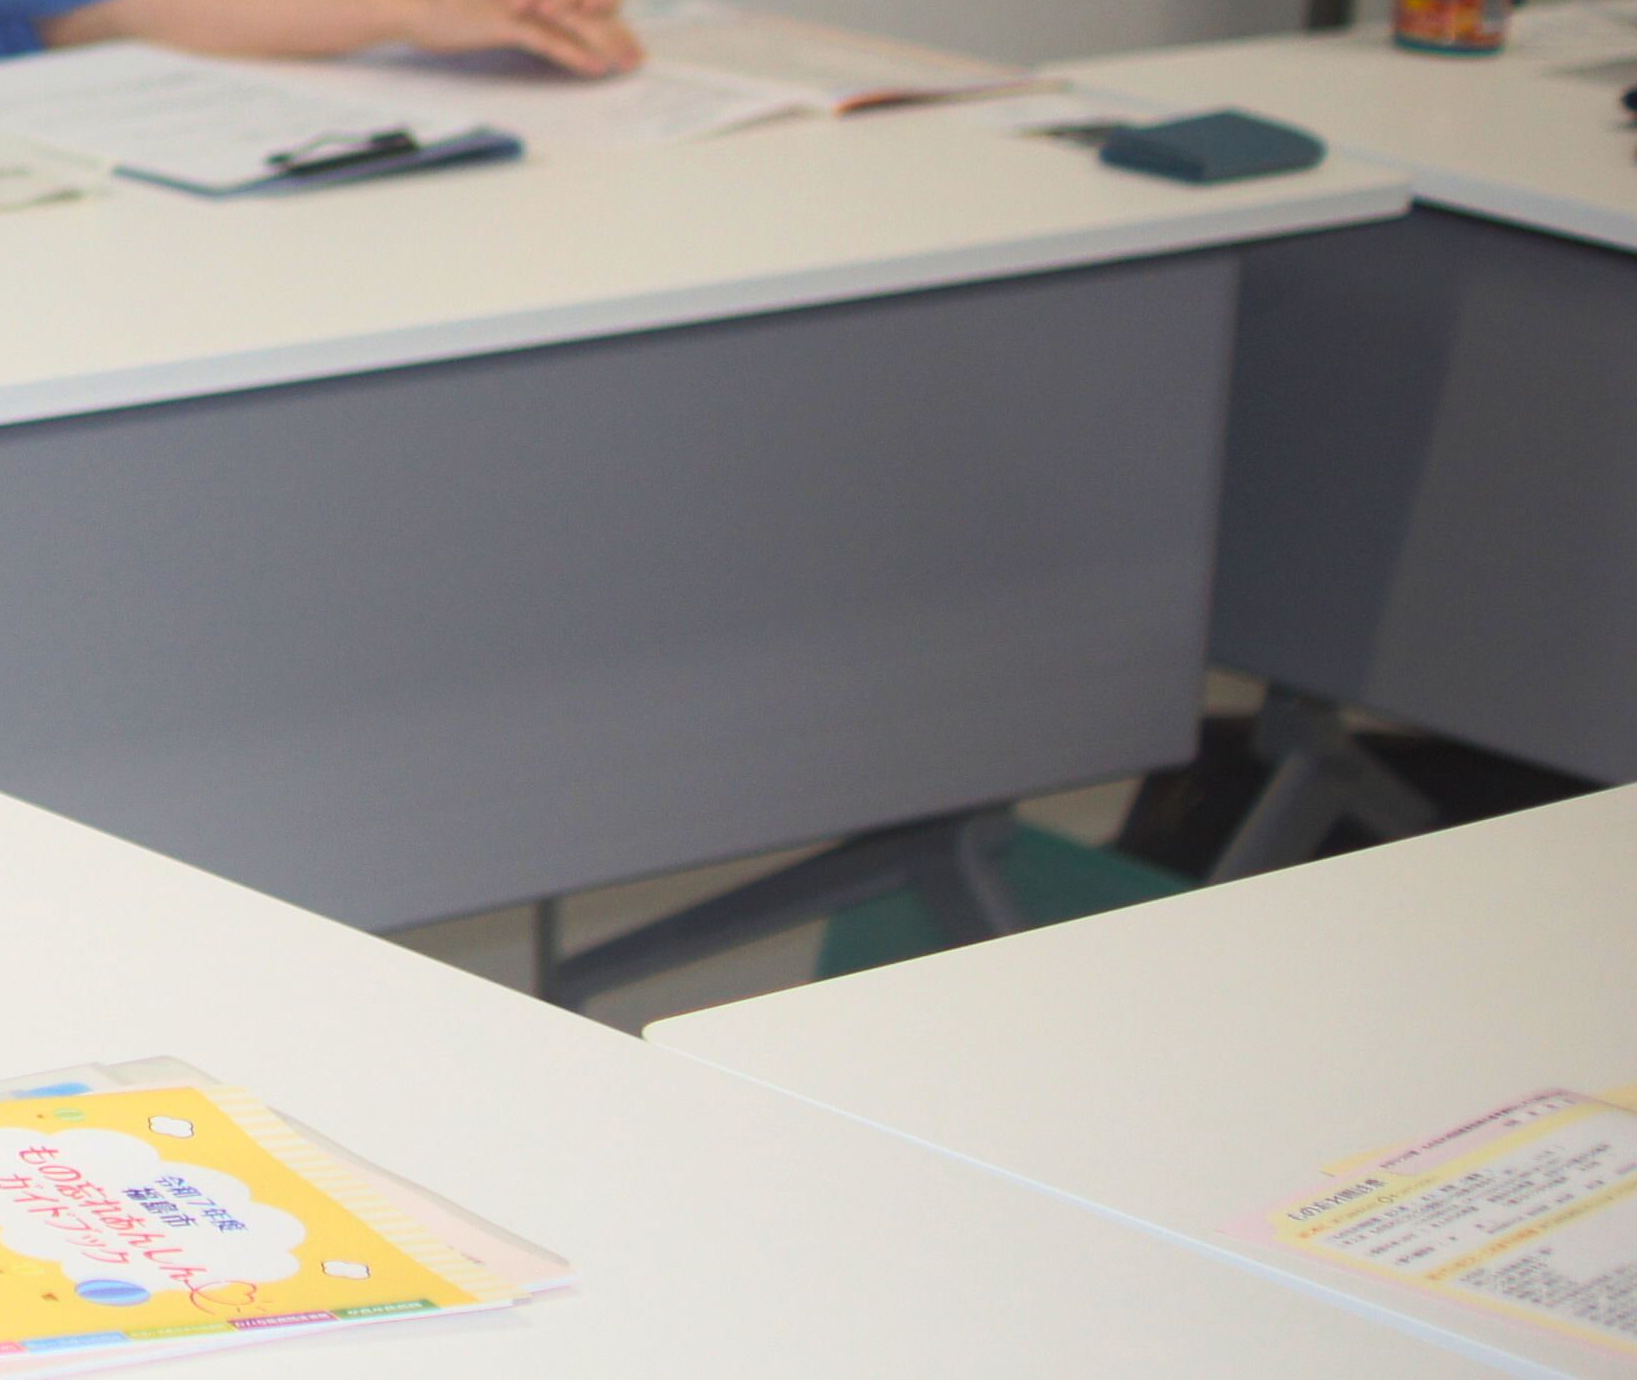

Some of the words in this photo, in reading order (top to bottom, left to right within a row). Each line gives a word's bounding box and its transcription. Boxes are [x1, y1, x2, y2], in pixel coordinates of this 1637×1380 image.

[19, 1146, 208, 1282] もの忘れあんしん
[122, 1186, 198, 1228] 福島市
